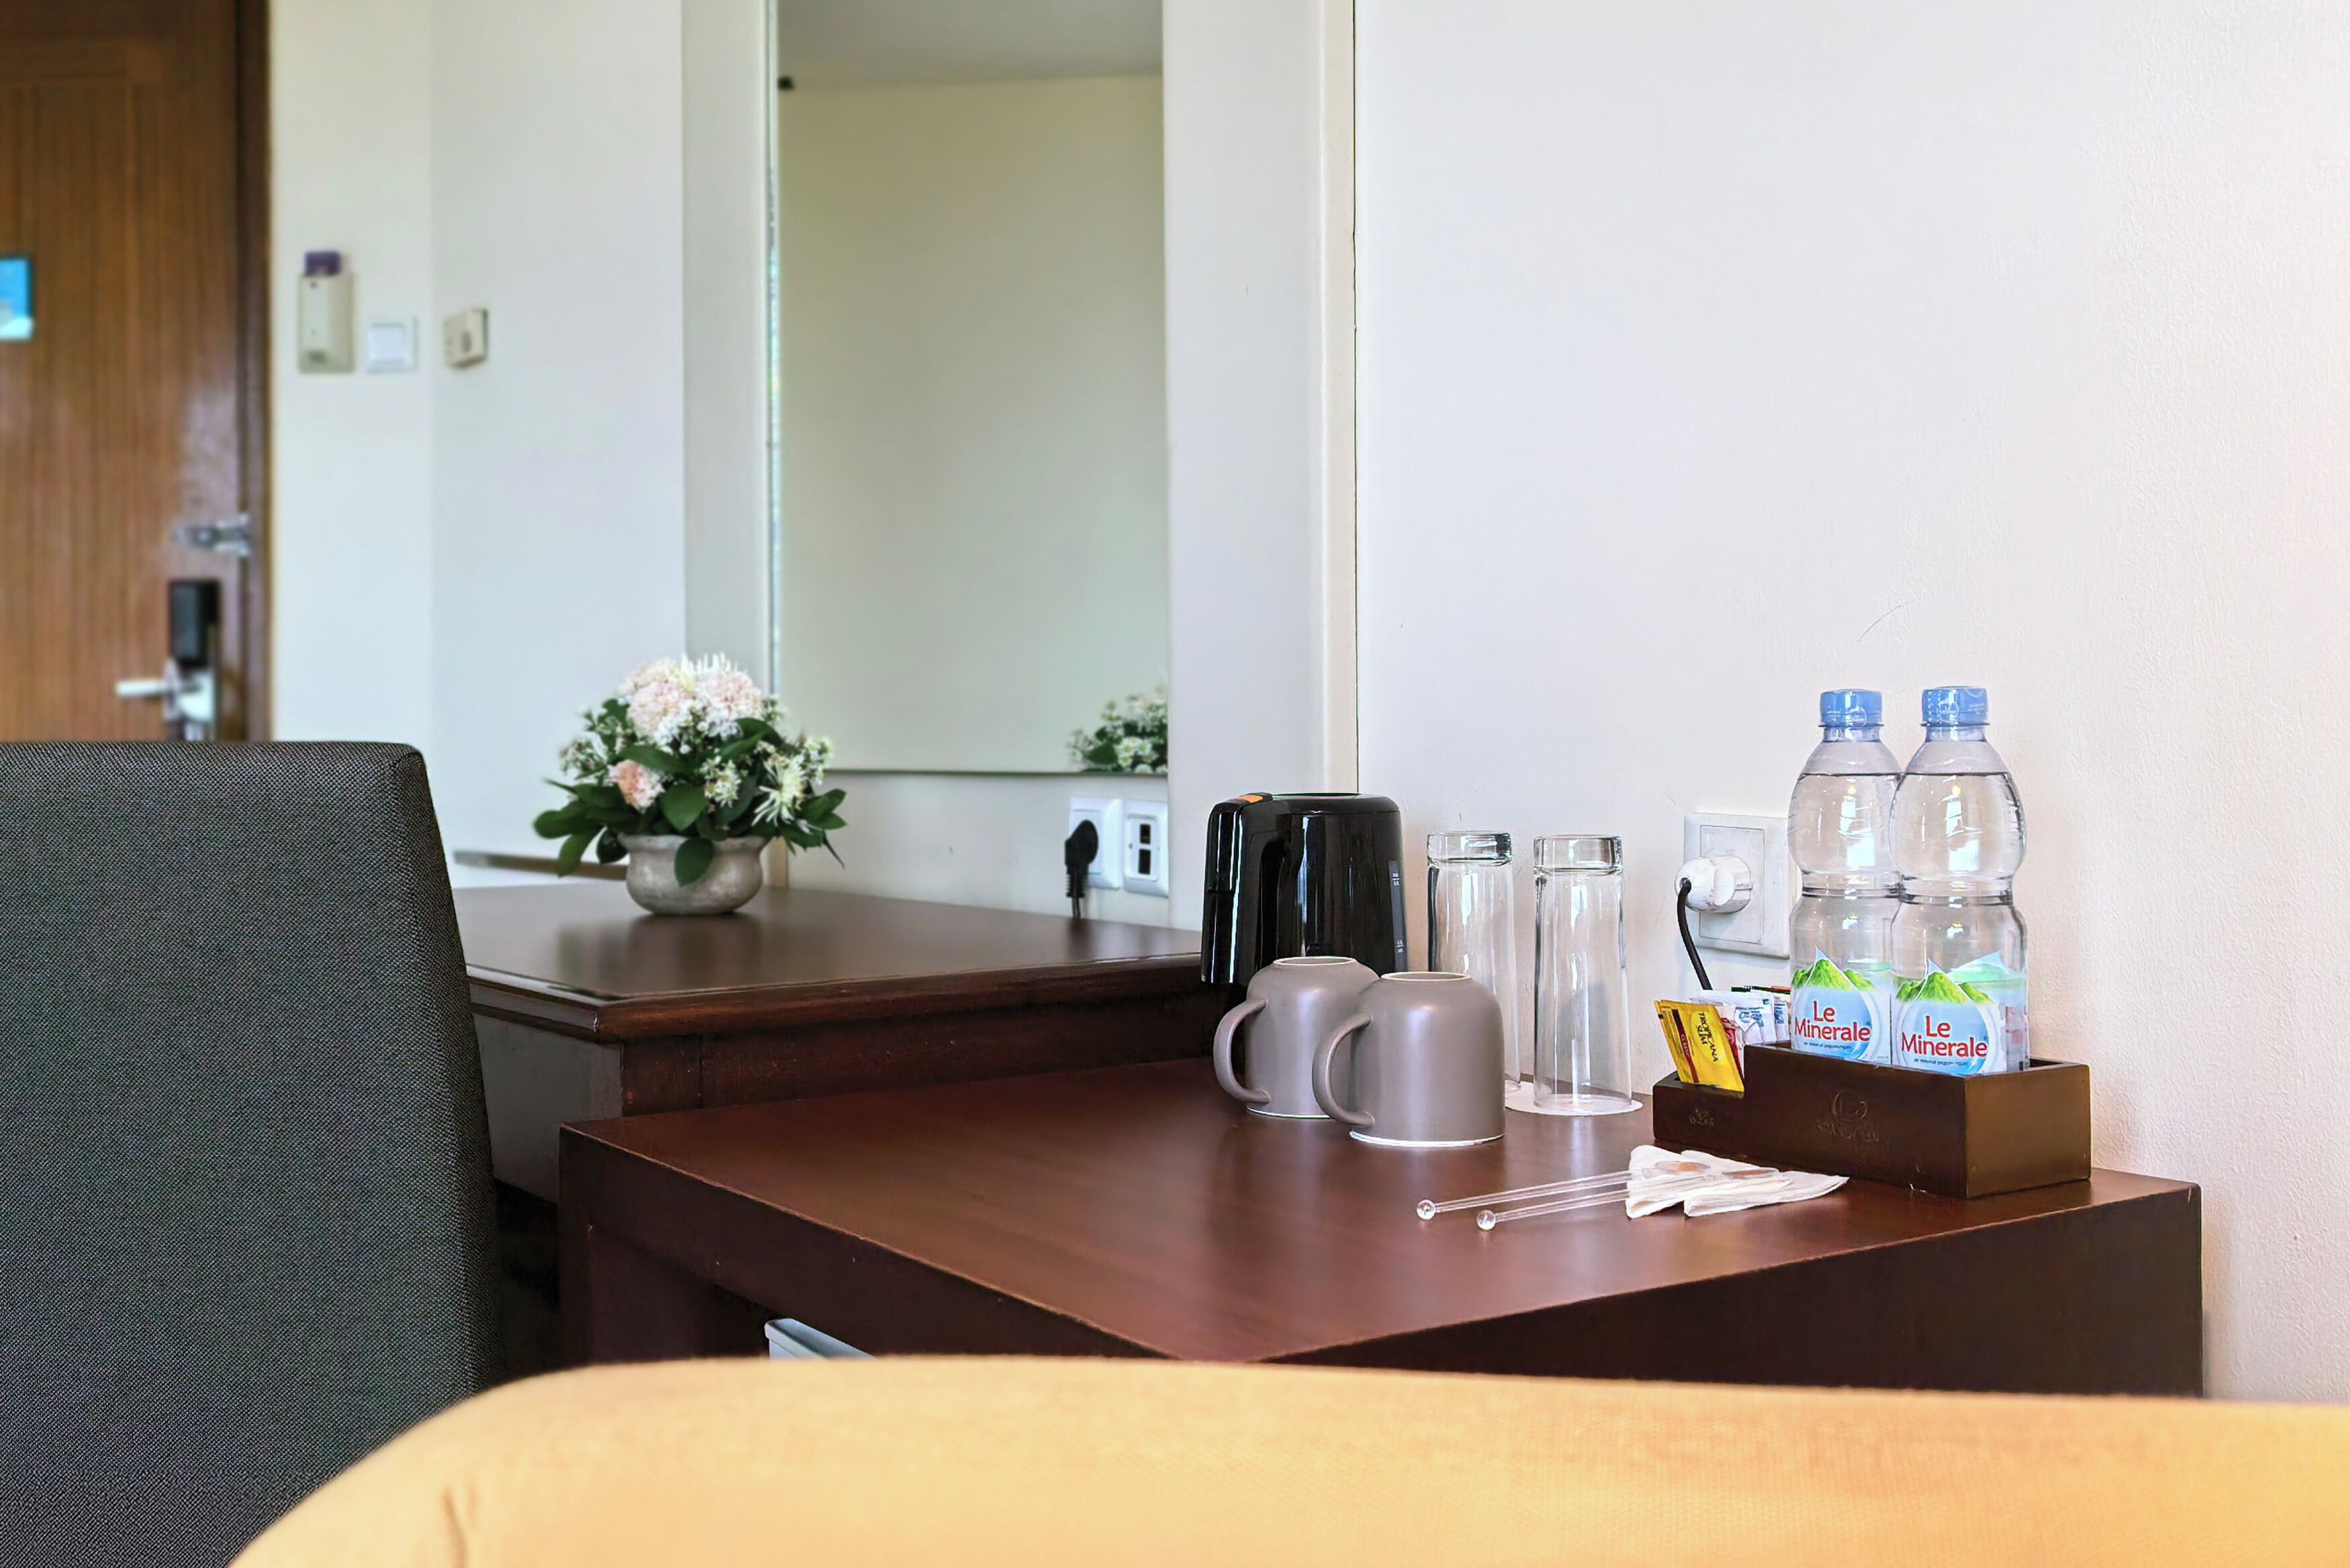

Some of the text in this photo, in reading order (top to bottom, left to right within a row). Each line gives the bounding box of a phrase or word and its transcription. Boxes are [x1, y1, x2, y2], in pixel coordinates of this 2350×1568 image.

[1814, 1000, 1835, 1022] Le
[1699, 1012, 1718, 1062] TROPICANA
[1795, 1016, 1871, 1041] Minerale
[1926, 1016, 1950, 1038] Le
[1901, 1032, 1987, 1057] Minerale
